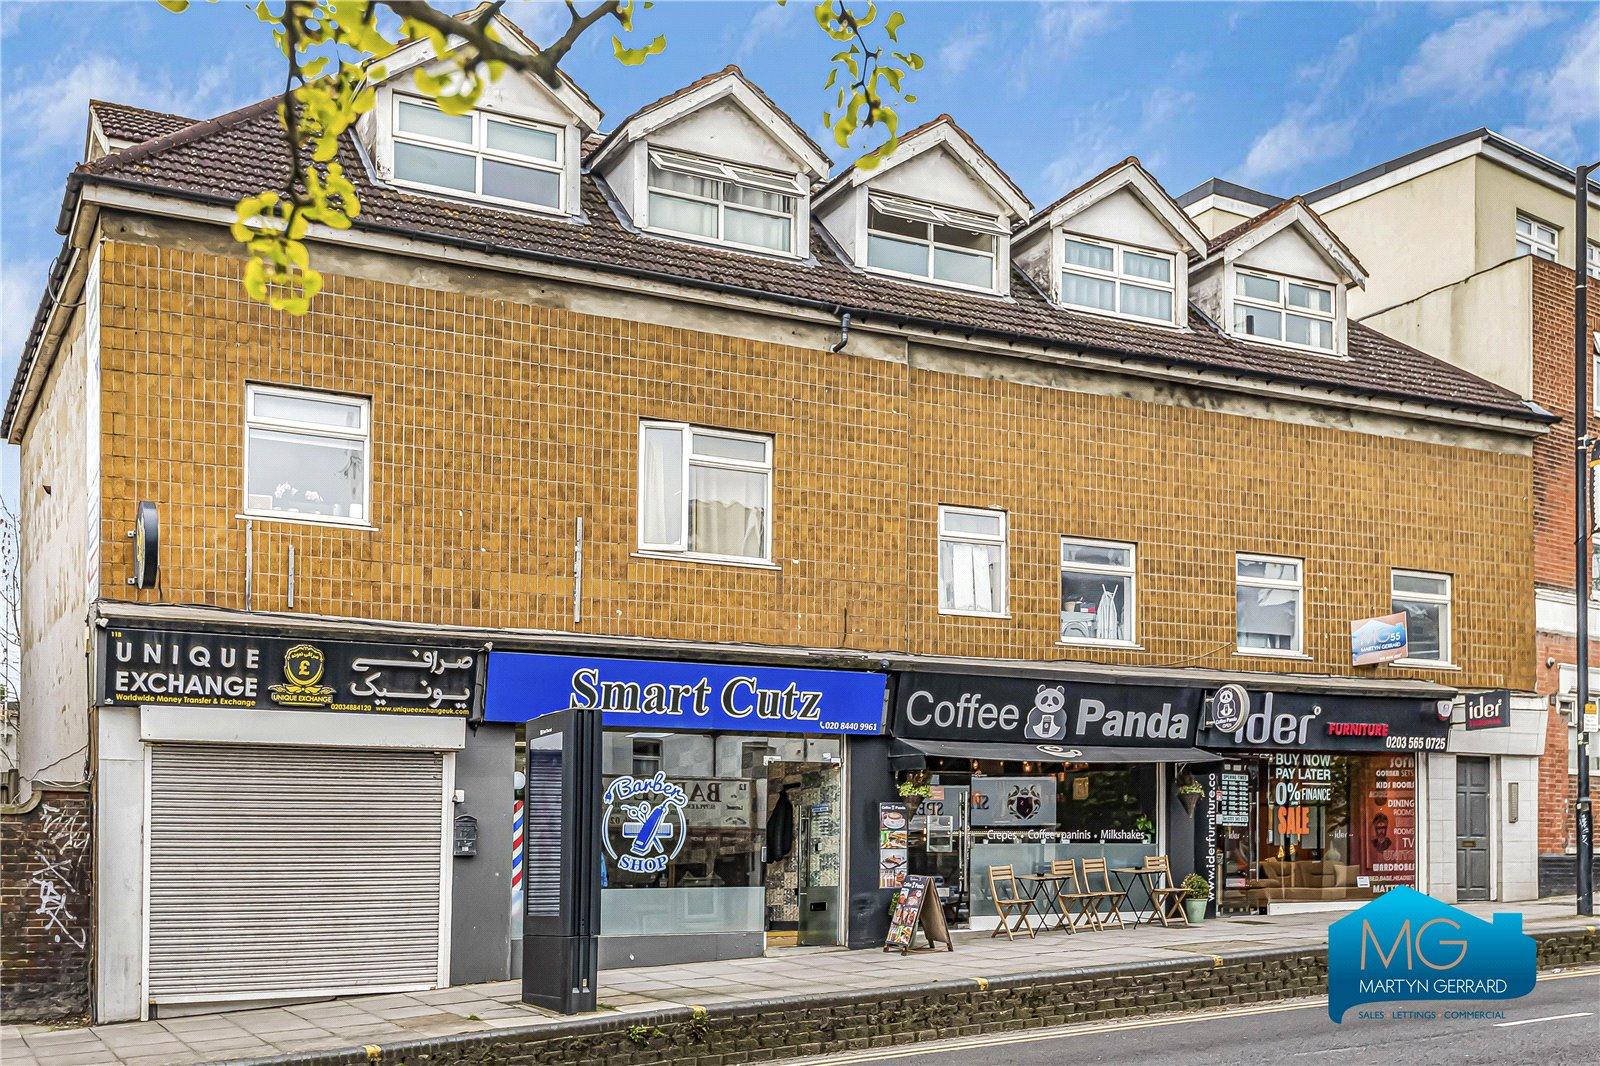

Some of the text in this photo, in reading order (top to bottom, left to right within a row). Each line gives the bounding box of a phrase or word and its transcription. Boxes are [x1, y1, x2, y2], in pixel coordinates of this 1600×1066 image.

[115, 641, 260, 669] UNIQUE
[115, 670, 258, 698] EXCHANGE
[115, 693, 156, 703] Worldwide
[156, 695, 183, 705] Money
[183, 697, 212, 705] Transfer
[219, 698, 256, 707] Exchange
[570, 668, 823, 720] Smart Cutz
[330, 703, 470, 715] 02034884120 www.uniqueexchangeuk.com
[906, 690, 1189, 739] Coffee Panda
[1469, 696, 1502, 720] ider
[825, 722, 877, 731] 020 8440 9961
[1328, 722, 1389, 737] FURNITURE
[1386, 735, 1446, 750] 0203 565 0725
[1275, 753, 1331, 767] BUY NOW
[1275, 768, 1331, 781] PAY LATER
[615, 771, 685, 800] Barber
[1375, 781, 1414, 789] KIDS ROOMS
[1275, 782, 1331, 805] 0% FINANCE
[1387, 799, 1414, 808] DINING
[1277, 806, 1310, 835] SALE
[987, 830, 1145, 842] Crepes Coffee paninis Milkshakes
[1205, 773, 1216, 902] www.iderfurniture.co
[1334, 829, 1348, 839] ider
[1393, 827, 1414, 835] ROOMS
[1402, 837, 1414, 848] TV
[617, 854, 669, 873] SHOP
[1372, 863, 1414, 872] WARDROBES
